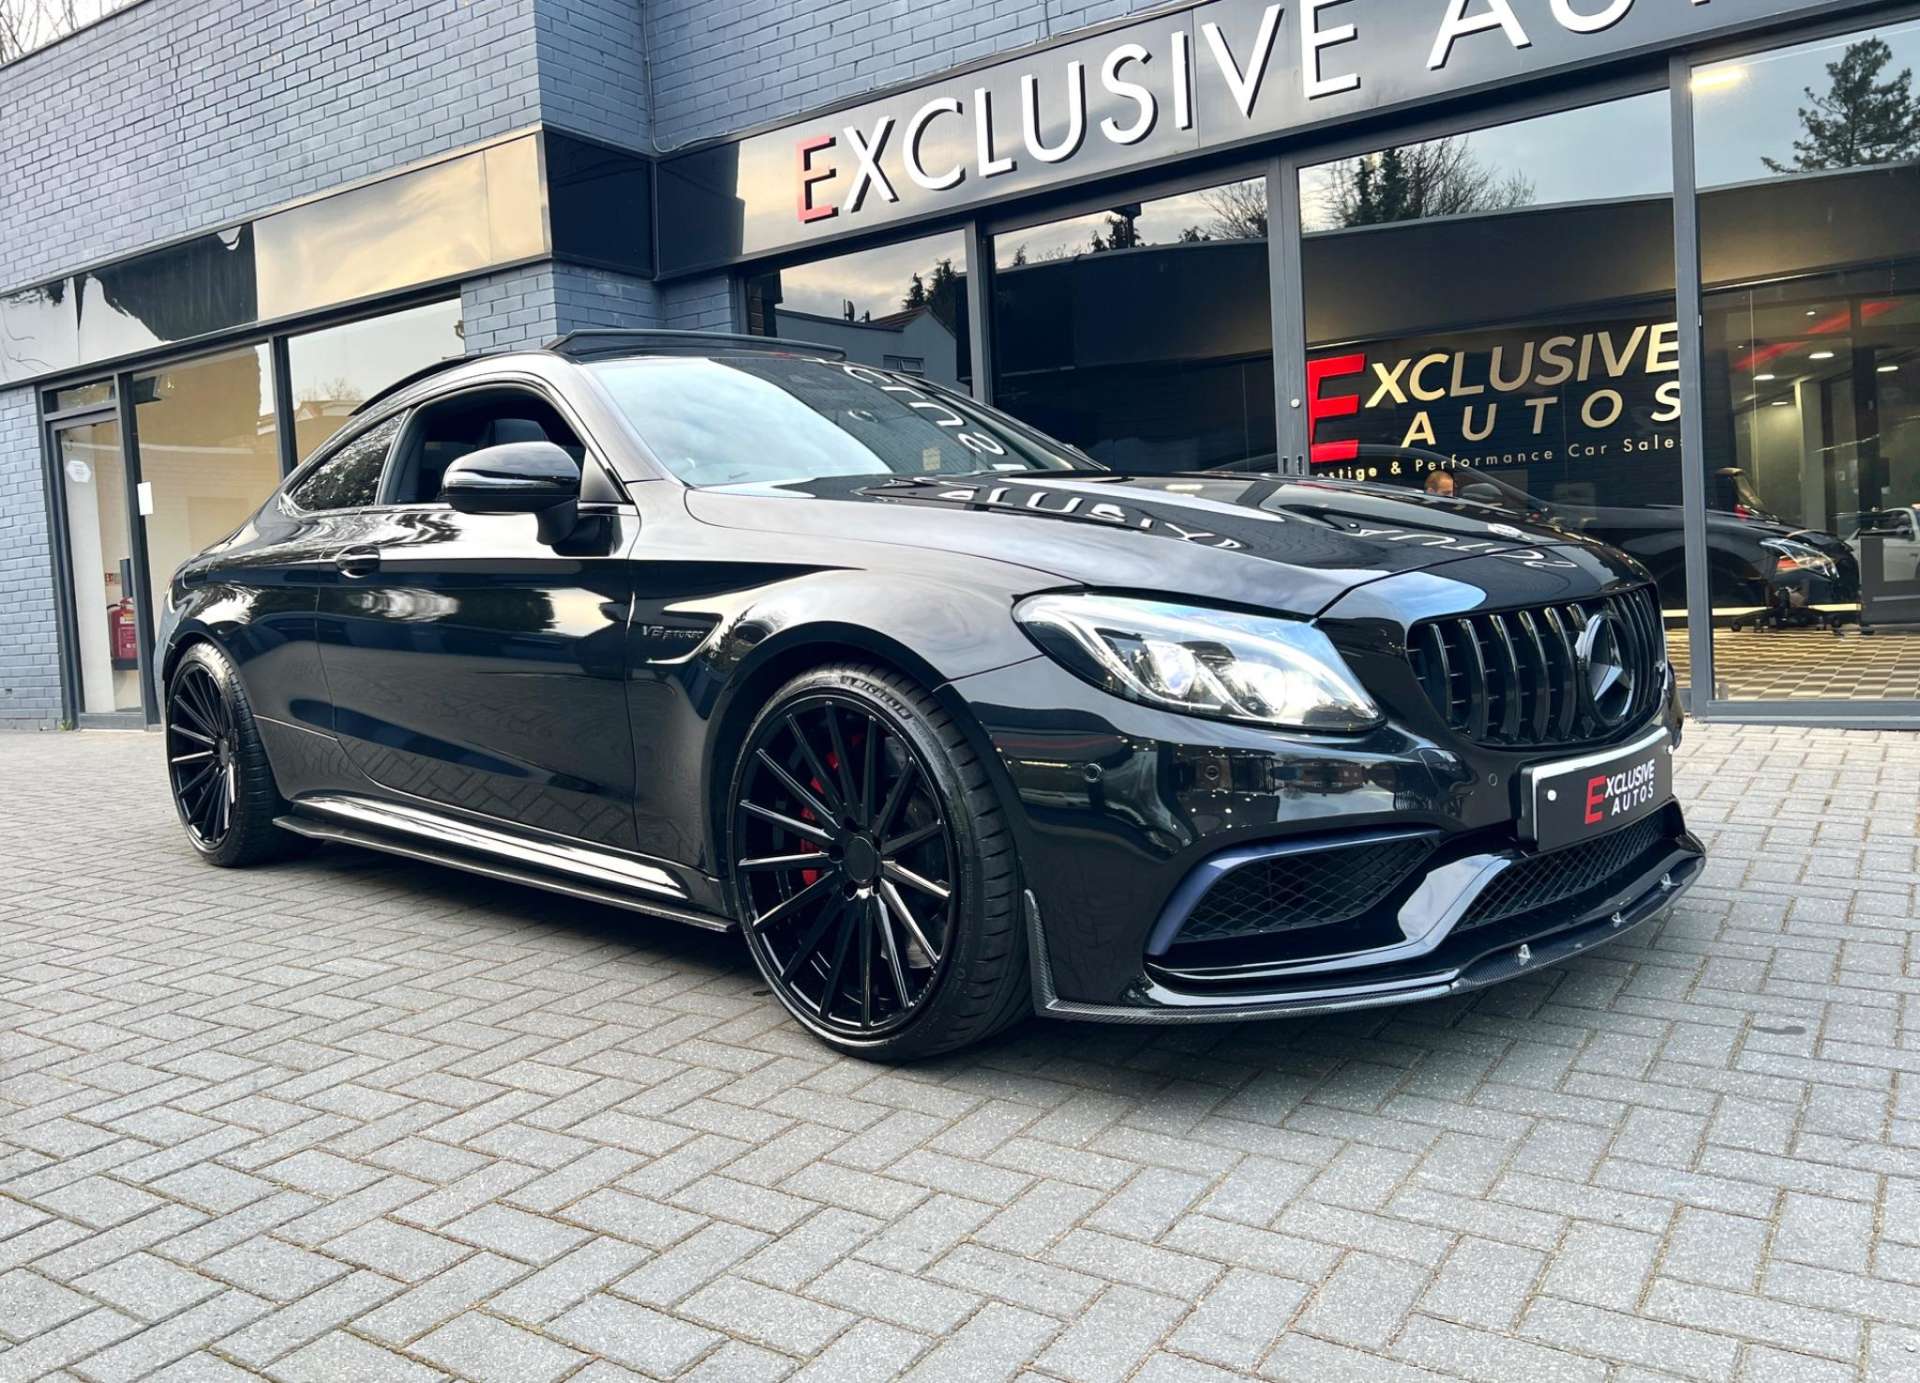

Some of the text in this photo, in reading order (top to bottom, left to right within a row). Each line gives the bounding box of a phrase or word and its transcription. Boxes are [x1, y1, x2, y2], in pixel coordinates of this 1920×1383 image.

[796, 0, 1359, 223] EXCLUSIVE
[1306, 321, 1680, 464] EXCLUSIVE
[1401, 380, 1681, 448] AUTOS
[1390, 461, 1402, 475] &
[1415, 450, 1553, 472] Performance
[1568, 443, 1607, 457] Car
[1584, 758, 1656, 825] EXCLUSIVE
[1611, 781, 1654, 816] AUTOS
